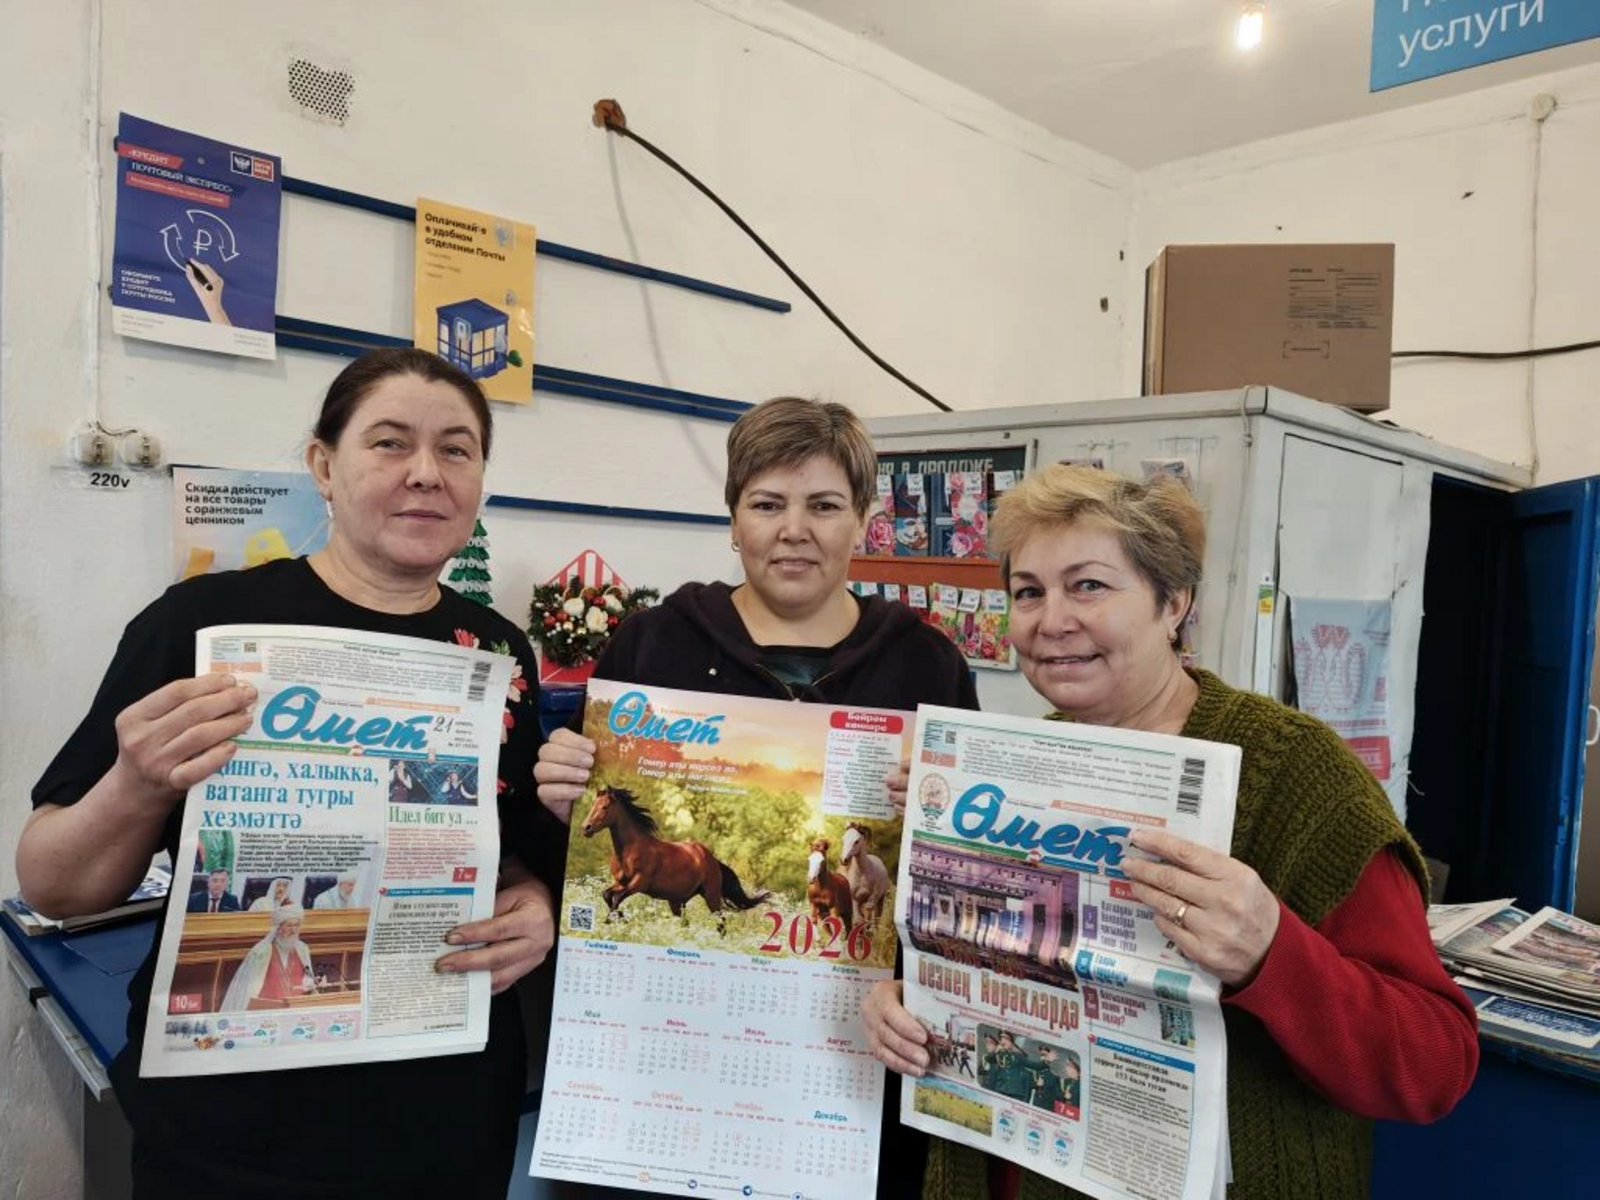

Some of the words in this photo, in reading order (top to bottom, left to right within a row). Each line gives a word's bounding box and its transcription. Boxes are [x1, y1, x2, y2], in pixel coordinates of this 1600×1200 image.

[1397, 0, 1545, 68] услуги
[132, 162, 183, 181] ПОЧТОВЫЙ
[432, 226, 473, 243] удобном
[425, 237, 475, 254] отделении
[476, 248, 506, 262] Почты
[185, 482, 229, 495] Скидка
[230, 484, 290, 498] действует
[185, 494, 200, 503] на
[201, 494, 221, 505] все
[224, 495, 267, 506] товары
[185, 516, 245, 525] ценником
[193, 506, 263, 516] оранжевым
[260, 685, 434, 750] Өмет
[608, 691, 725, 746] Өмет
[287, 761, 380, 785] халыкка,
[205, 784, 288, 805] ватанга
[297, 788, 354, 811] тугры
[201, 809, 302, 829] хезмәттә
[389, 806, 420, 825] Идел
[425, 807, 445, 824] бит
[448, 812, 462, 828] ул
[952, 783, 1132, 866] Өмет
[759, 912, 872, 962] 2026
[667, 948, 700, 958] Февраль
[918, 954, 971, 1003] безнең
[175, 995, 188, 1009] 10
[827, 1037, 853, 1046] Август
[814, 1110, 848, 1122] Декабрь
